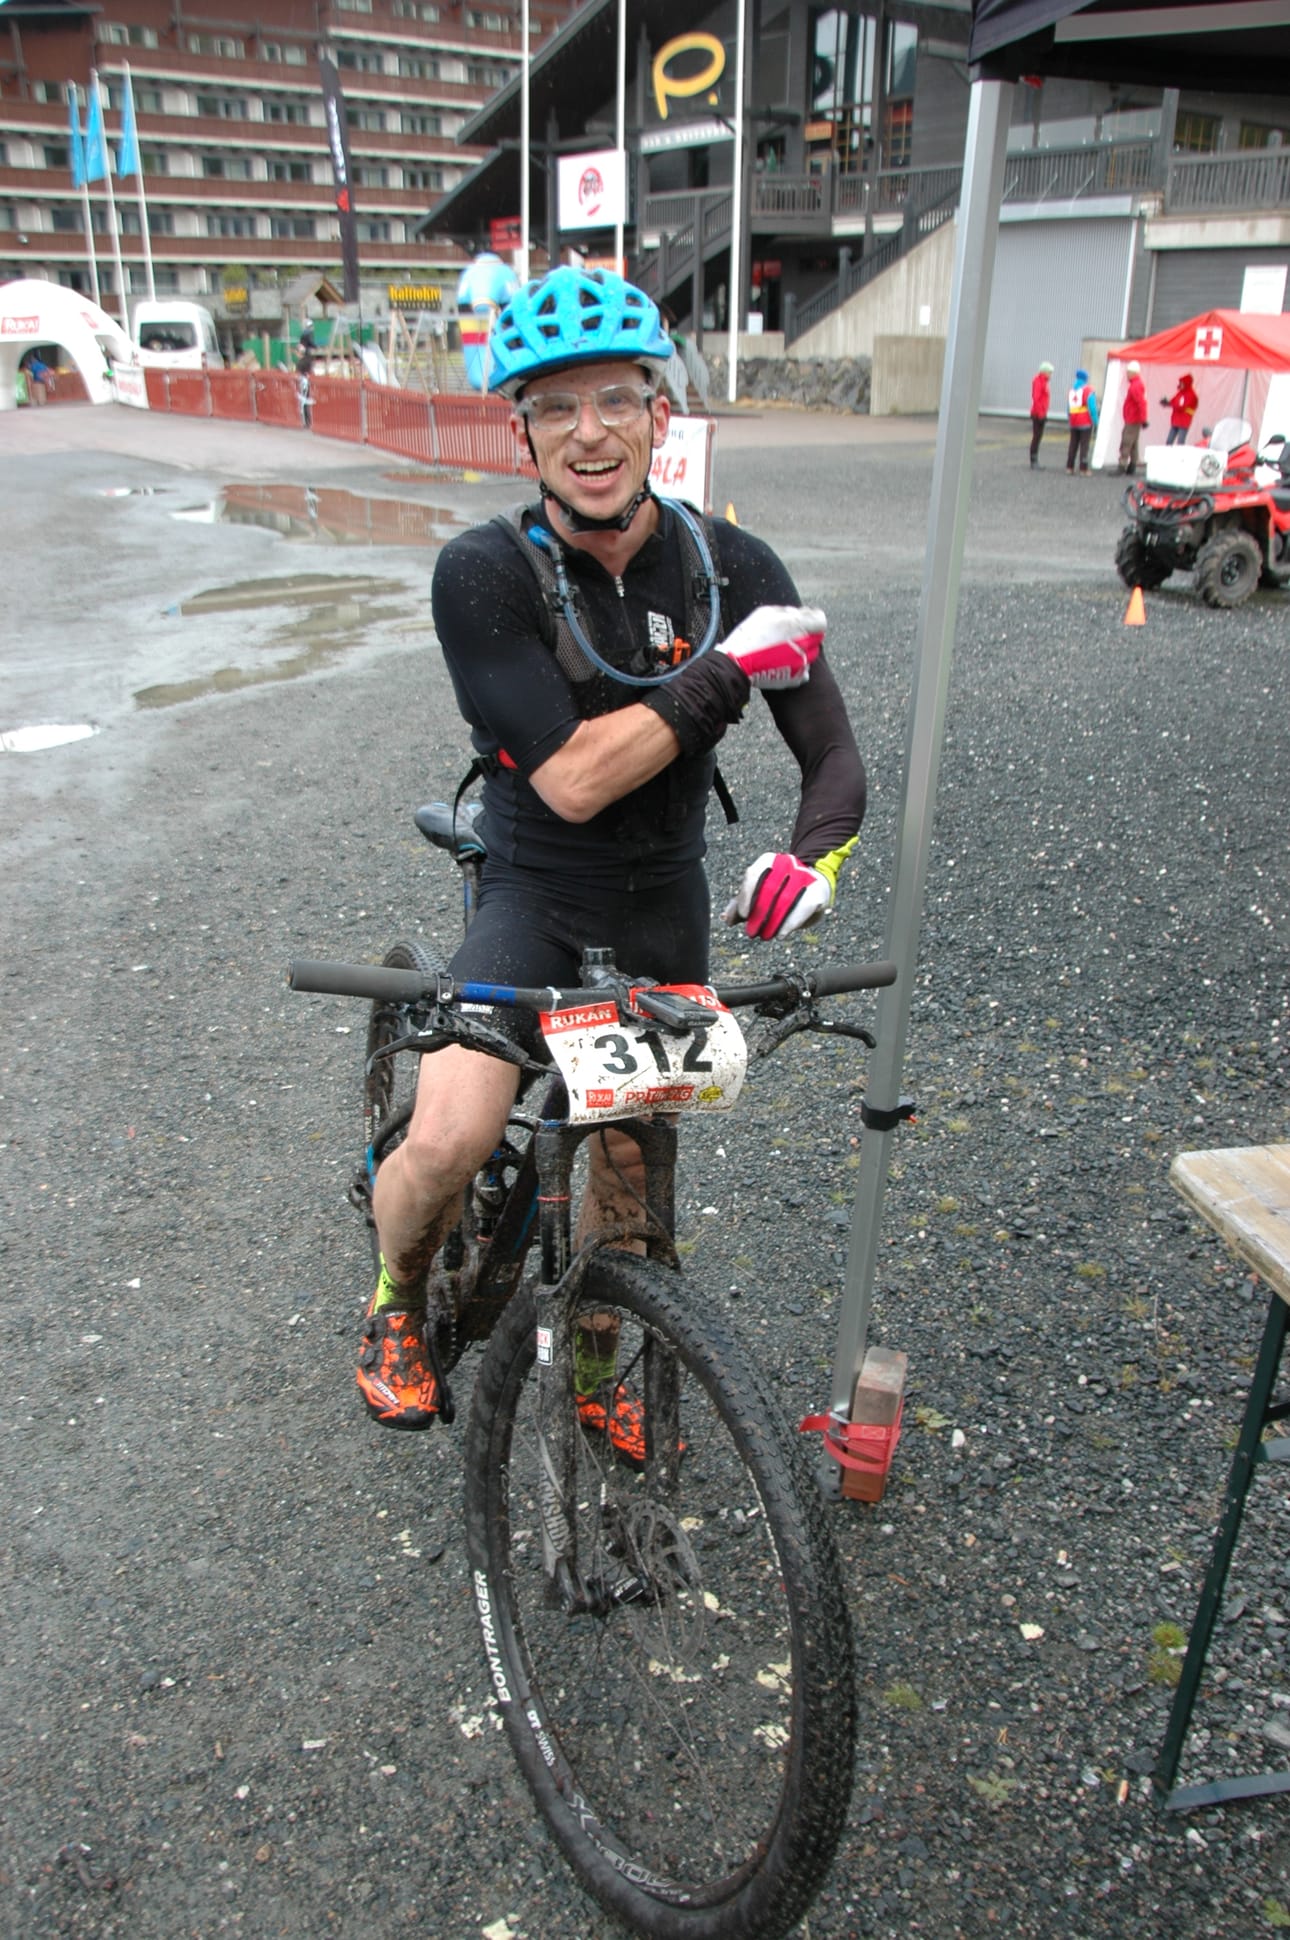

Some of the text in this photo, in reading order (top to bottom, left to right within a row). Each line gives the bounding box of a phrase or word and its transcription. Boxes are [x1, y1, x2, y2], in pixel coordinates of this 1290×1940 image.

[550, 1008, 612, 1030] RUKAN
[594, 1027, 713, 1075] 312
[474, 1569, 512, 1701] BONTRAGER
[527, 1710, 556, 1767] DT SWISS
